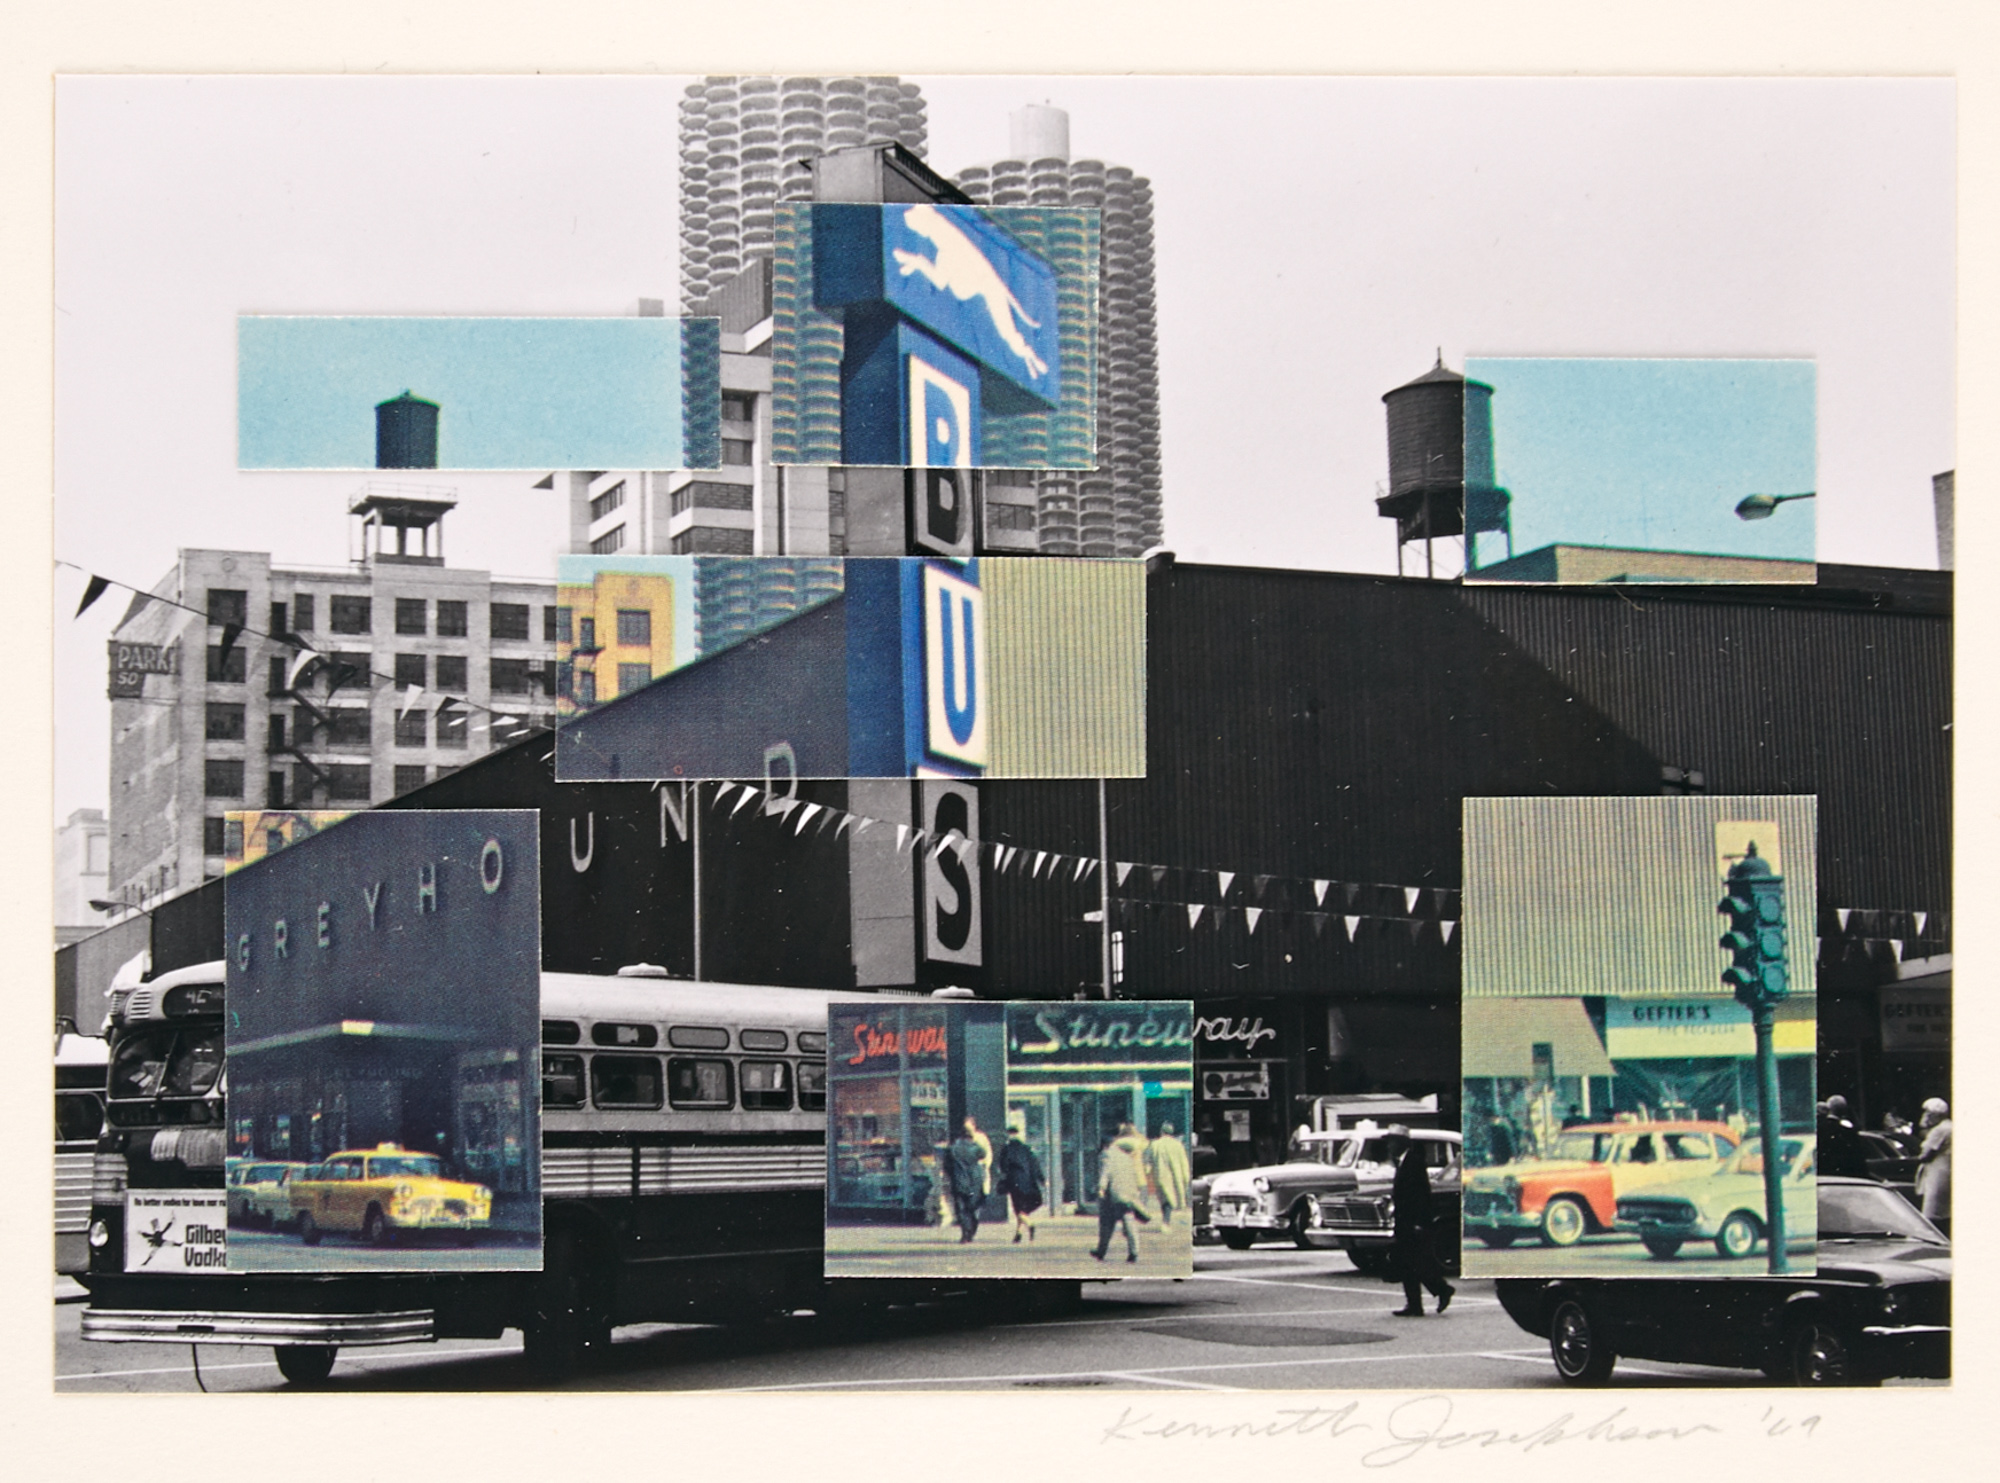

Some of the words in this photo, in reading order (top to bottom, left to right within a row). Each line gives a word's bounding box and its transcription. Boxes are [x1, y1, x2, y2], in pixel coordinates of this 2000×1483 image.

[921, 375, 978, 953] BUS
[236, 741, 799, 972] GREYHOUND
[1633, 1005, 1710, 1021] GEFTER'S
